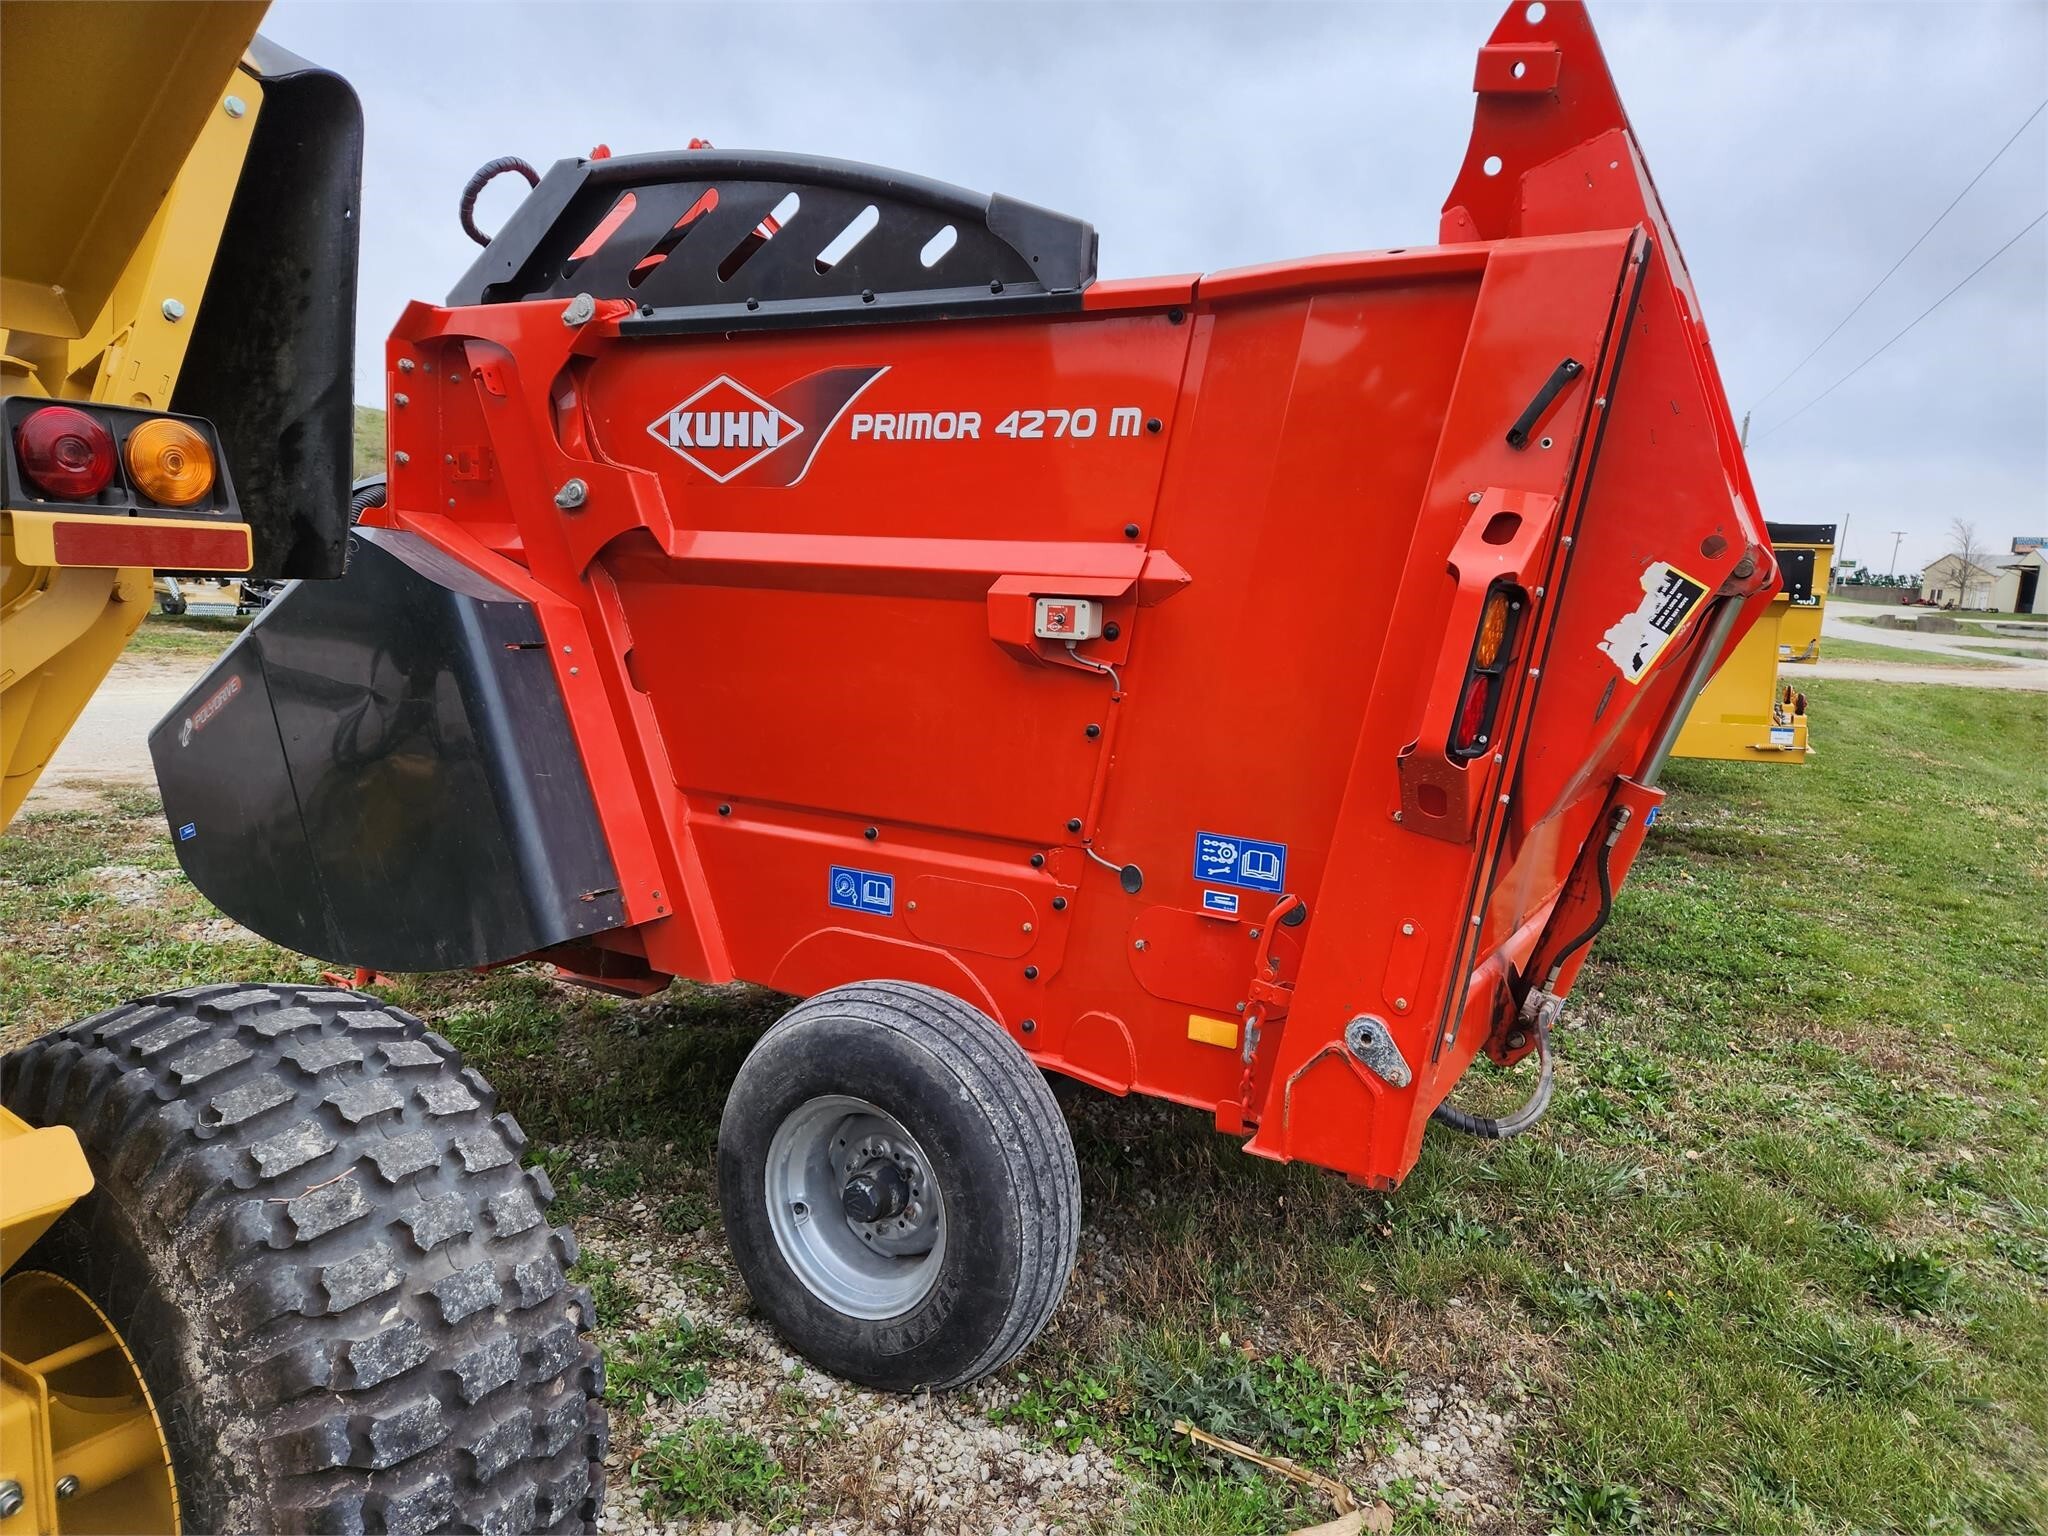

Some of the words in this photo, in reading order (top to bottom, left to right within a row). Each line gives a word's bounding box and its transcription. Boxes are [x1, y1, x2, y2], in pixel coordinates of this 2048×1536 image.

[669, 411, 779, 448] KUHN
[850, 411, 982, 440] PRIMOR
[994, 408, 1098, 439] 4270
[1108, 406, 1143, 437] M
